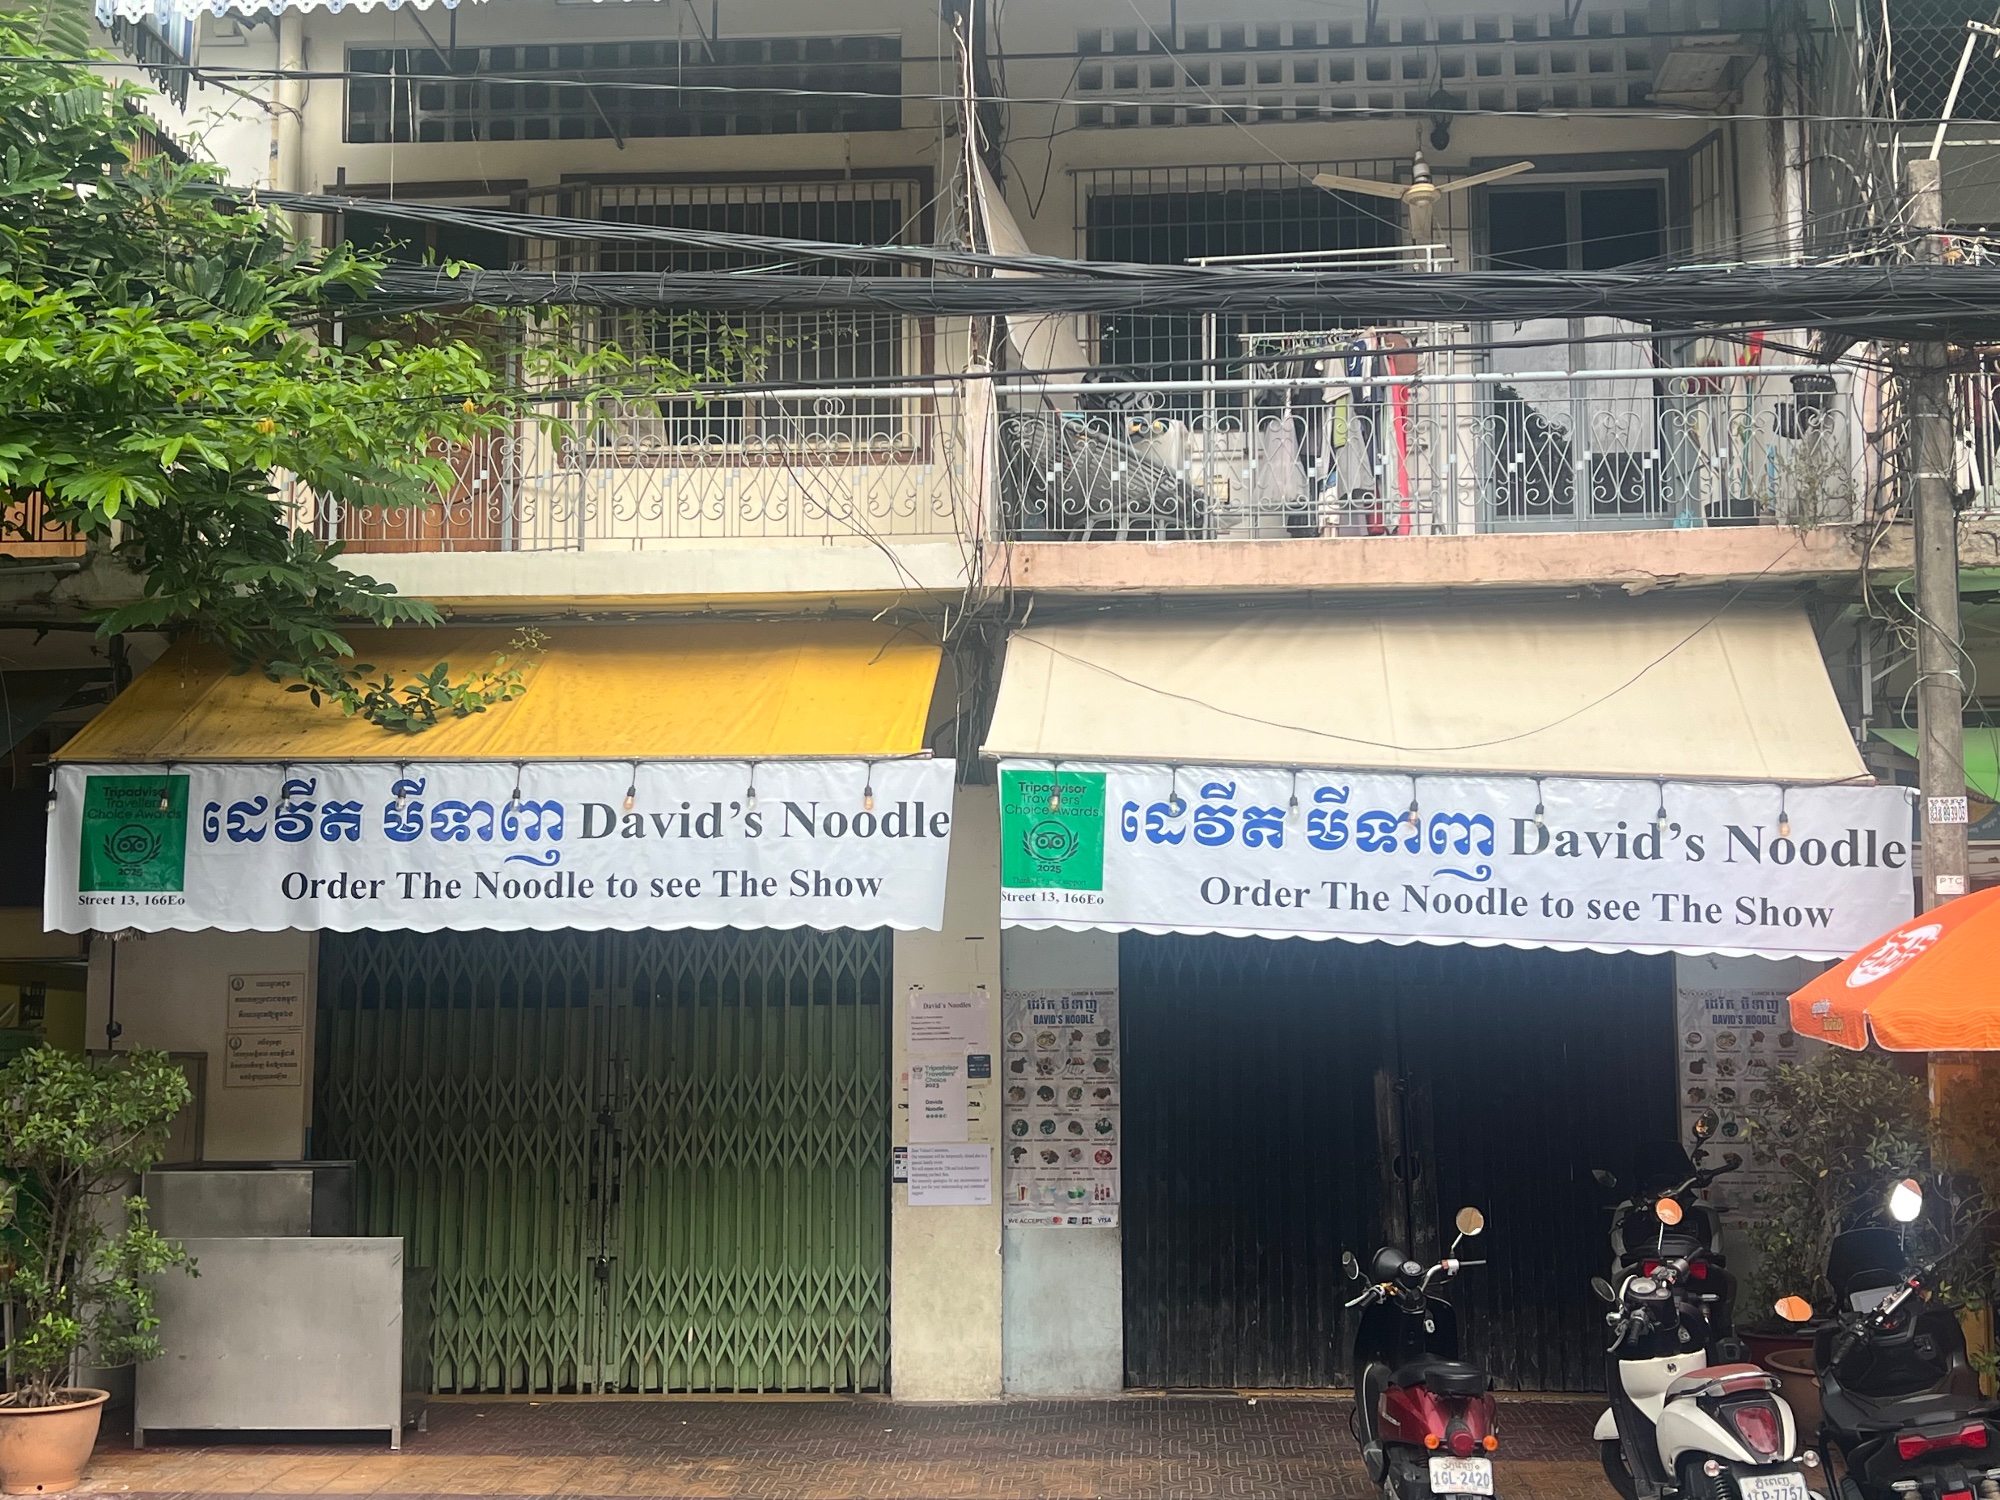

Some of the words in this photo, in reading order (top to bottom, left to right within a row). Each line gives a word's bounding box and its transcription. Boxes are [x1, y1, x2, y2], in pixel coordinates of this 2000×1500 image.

[103, 787, 169, 798] Tripadviso
[87, 809, 133, 819] Choice
[136, 810, 182, 819] Awards
[1005, 804, 1049, 815] Choice
[1052, 806, 1098, 817] Awards
[781, 800, 950, 839] Noodle
[1724, 824, 1907, 868] Noodle
[118, 868, 143, 876] 2025
[1037, 865, 1061, 873] 2025
[281, 871, 385, 901] Order
[396, 871, 462, 900] The
[474, 870, 594, 900] Noodle
[606, 873, 638, 899] to
[650, 876, 701, 899] see
[713, 870, 778, 898] The
[789, 869, 883, 899] Show
[78, 896, 115, 905] Street
[121, 896, 139, 906] 13,
[144, 896, 185, 905] 166Eo
[1001, 891, 1035, 902] Street
[1041, 892, 1059, 903] 13,
[1064, 893, 1104, 905] 166Eo
[1200, 876, 1310, 910] Order
[1320, 881, 1390, 911] The
[1402, 884, 1528, 917] Noodle
[1541, 891, 1574, 919] to
[1586, 897, 1641, 922] see
[1652, 892, 1722, 925] The
[1735, 896, 1834, 929] Show
[1034, 1015, 1063, 1024] DAVID'S
[1065, 1014, 1094, 1024] NOODLE
[1712, 1015, 1743, 1024] DAVID'S
[1745, 1015, 1776, 1024] NOODLE
[1434, 1471, 1490, 1487] 1GL-2420
